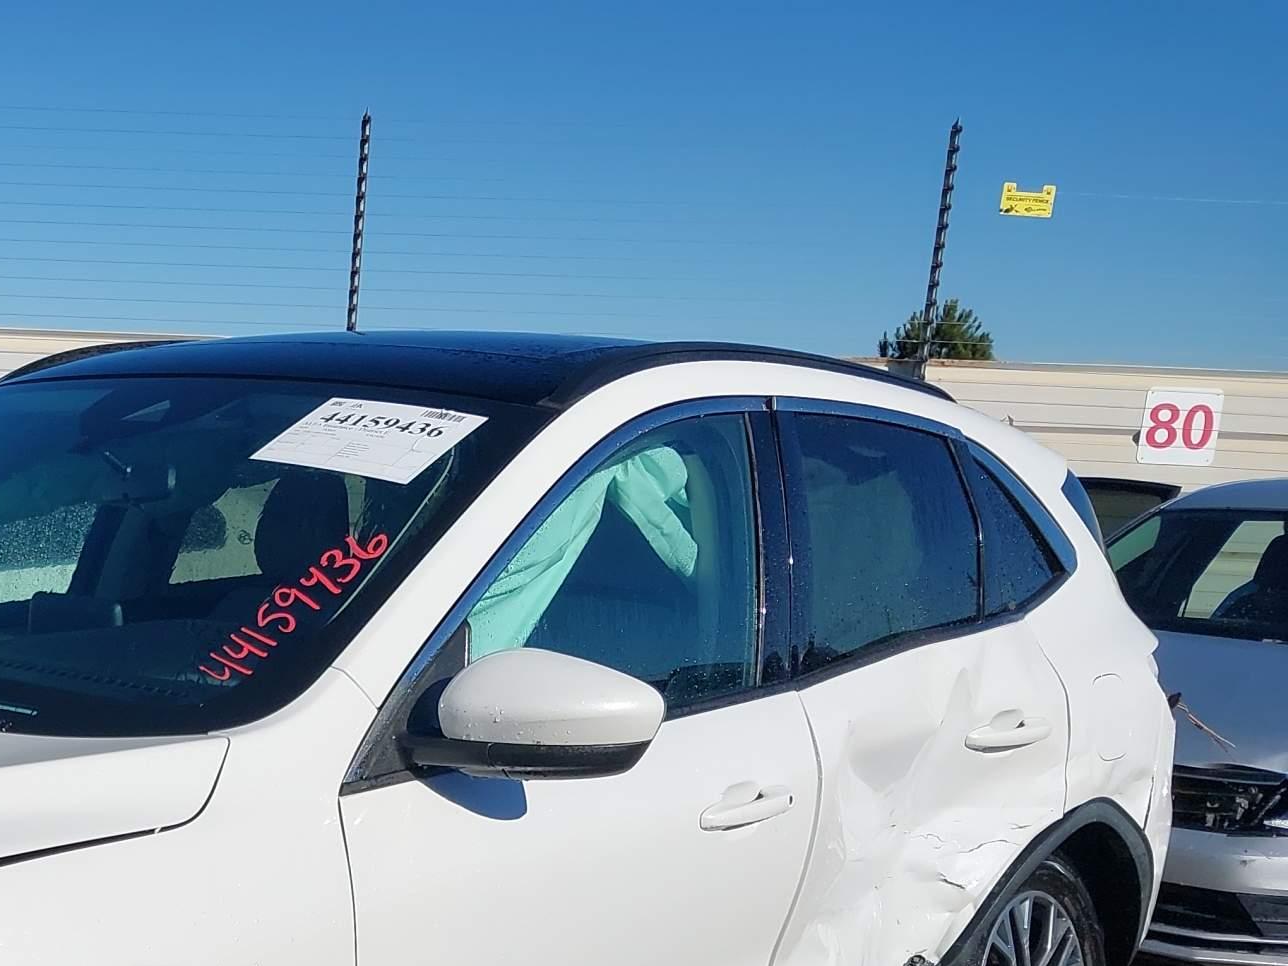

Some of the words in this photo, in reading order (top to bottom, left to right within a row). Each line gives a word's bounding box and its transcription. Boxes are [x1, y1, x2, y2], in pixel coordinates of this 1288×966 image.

[320, 411, 445, 438] 44159436
[1145, 403, 1214, 450] 80
[198, 533, 389, 681] 44159436
